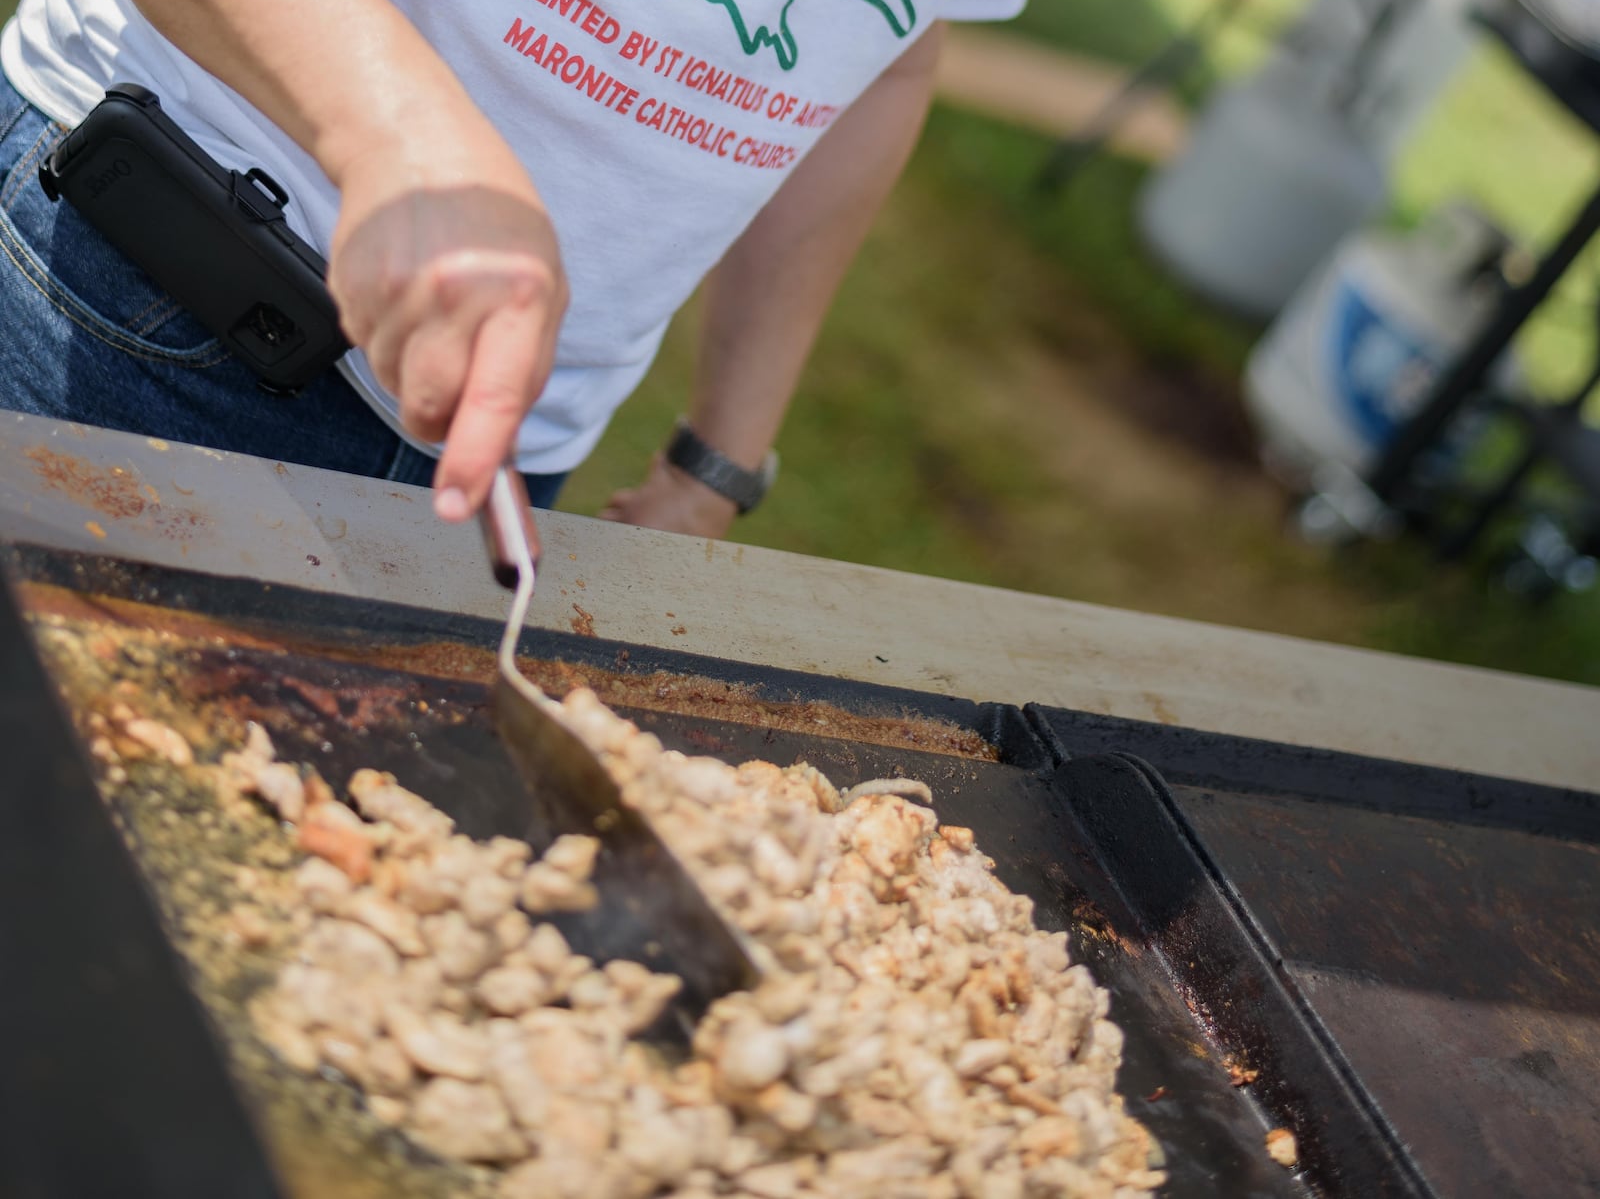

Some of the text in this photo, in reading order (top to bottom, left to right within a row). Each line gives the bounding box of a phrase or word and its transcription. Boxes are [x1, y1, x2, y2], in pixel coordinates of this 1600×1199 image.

[503, 17, 640, 115] MARONITE
[635, 97, 737, 157] CATHOLIC
[618, 30, 659, 67] BY
[654, 45, 684, 78] ST
[676, 55, 769, 113] IGNATIUS
[767, 92, 798, 122] OF
